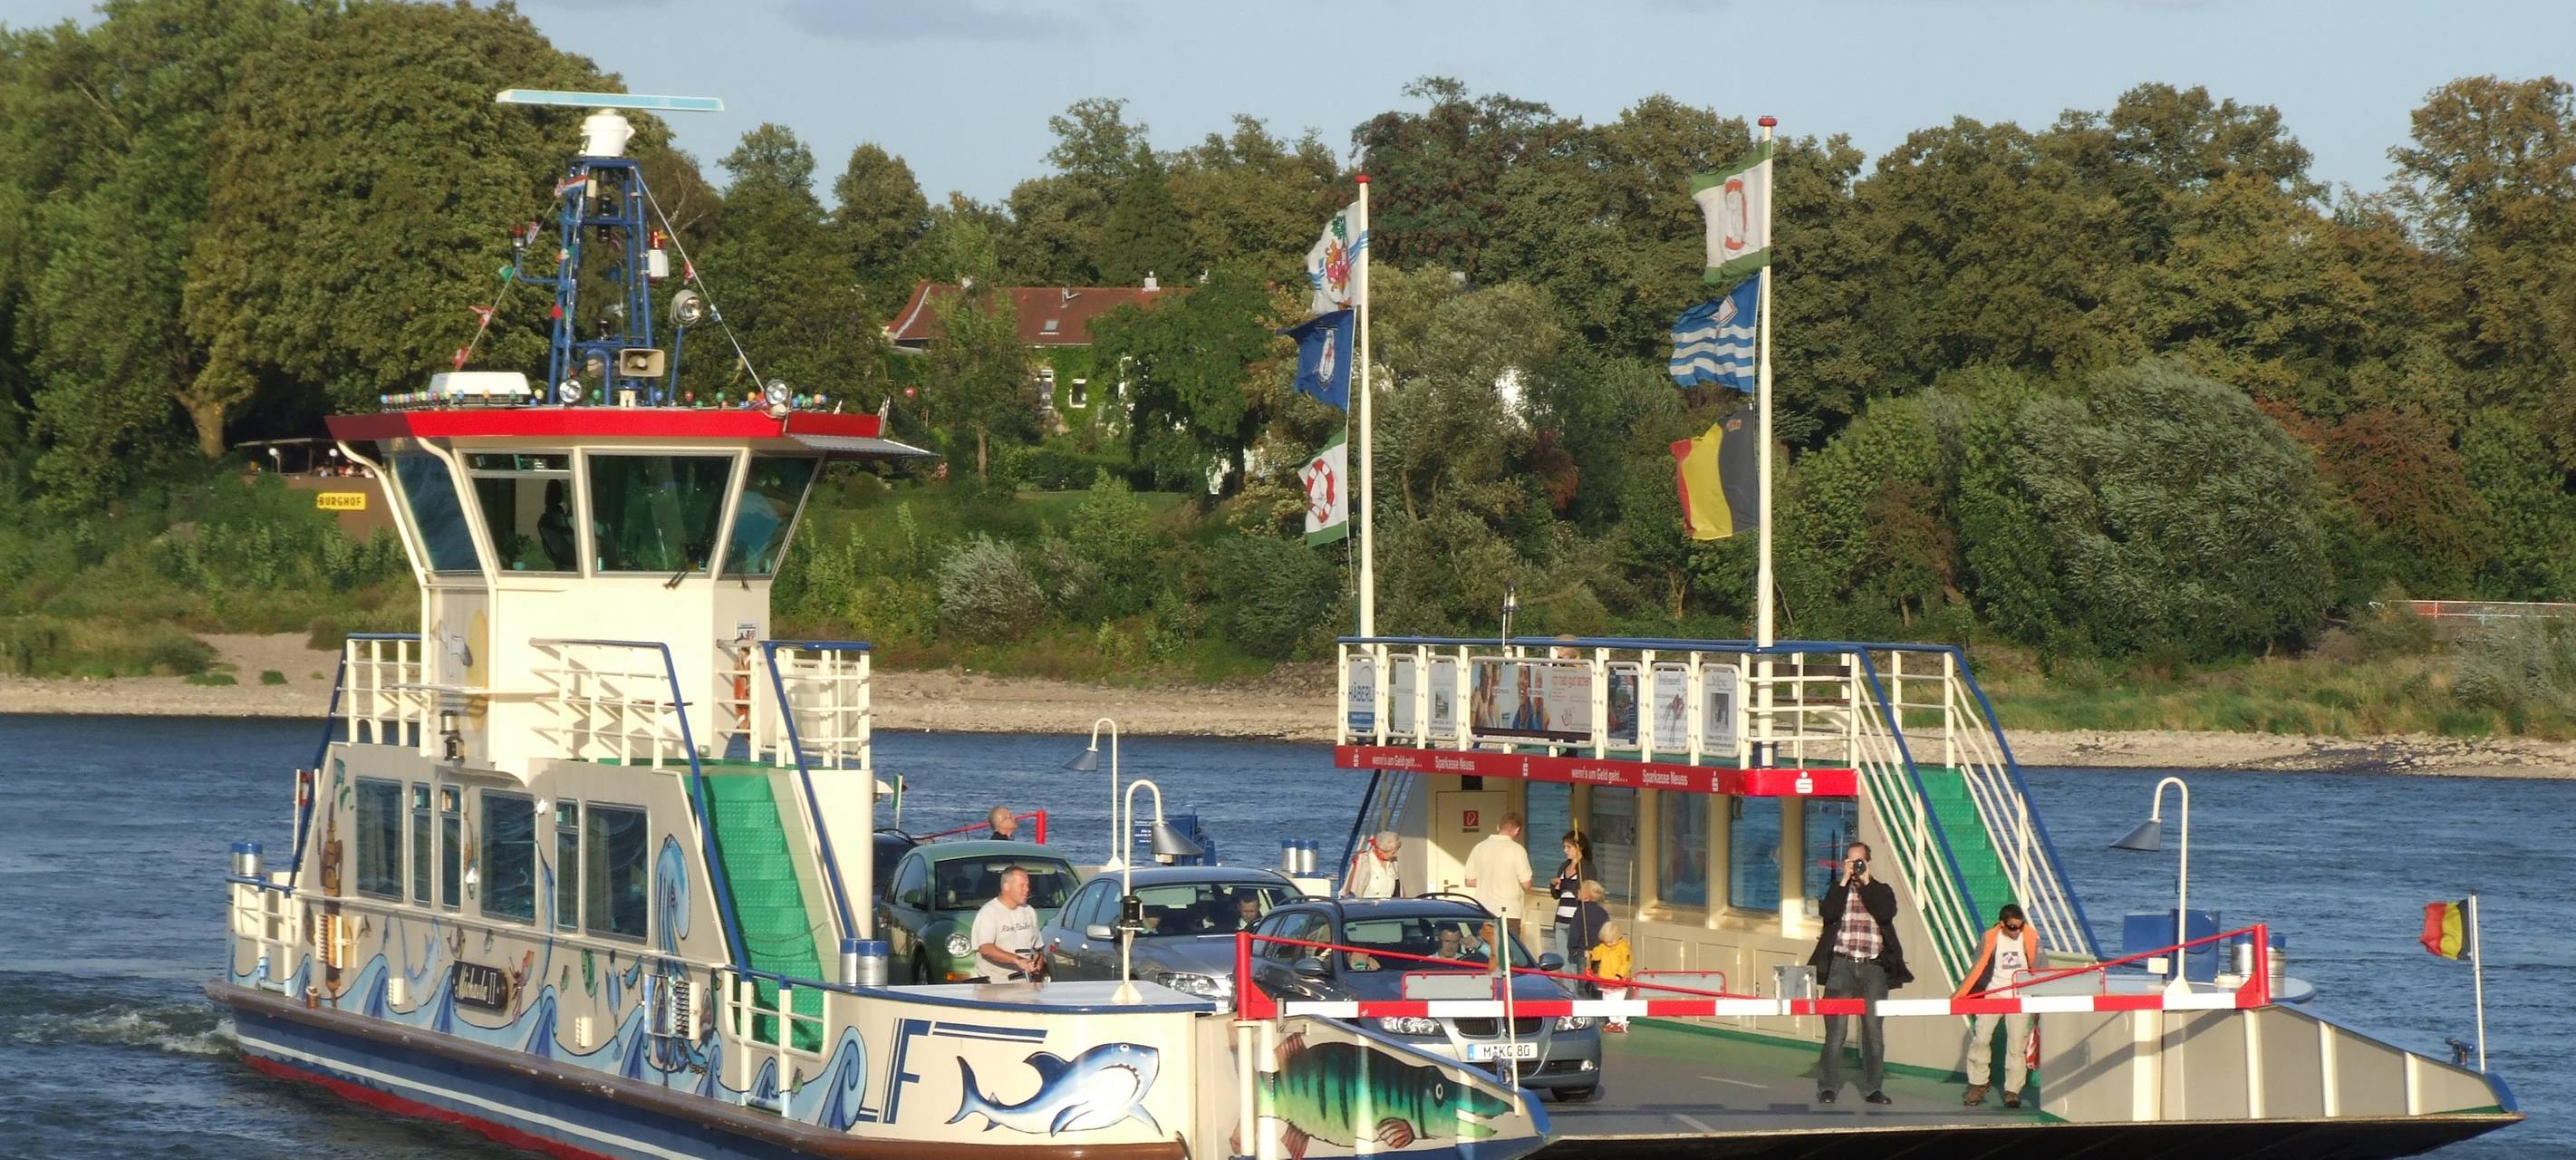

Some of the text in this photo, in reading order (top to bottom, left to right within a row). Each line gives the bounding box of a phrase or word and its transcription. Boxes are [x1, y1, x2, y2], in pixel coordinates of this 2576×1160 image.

[319, 497, 362, 506] BURGHOF
[1435, 756, 1459, 772] Sparkasse
[1460, 757, 1475, 770] Neuss
[1643, 769, 1669, 786] Sparkasse
[1670, 771, 1688, 786] Neuss
[1483, 1046, 1491, 1057] M
[1517, 1045, 1530, 1057] 80
